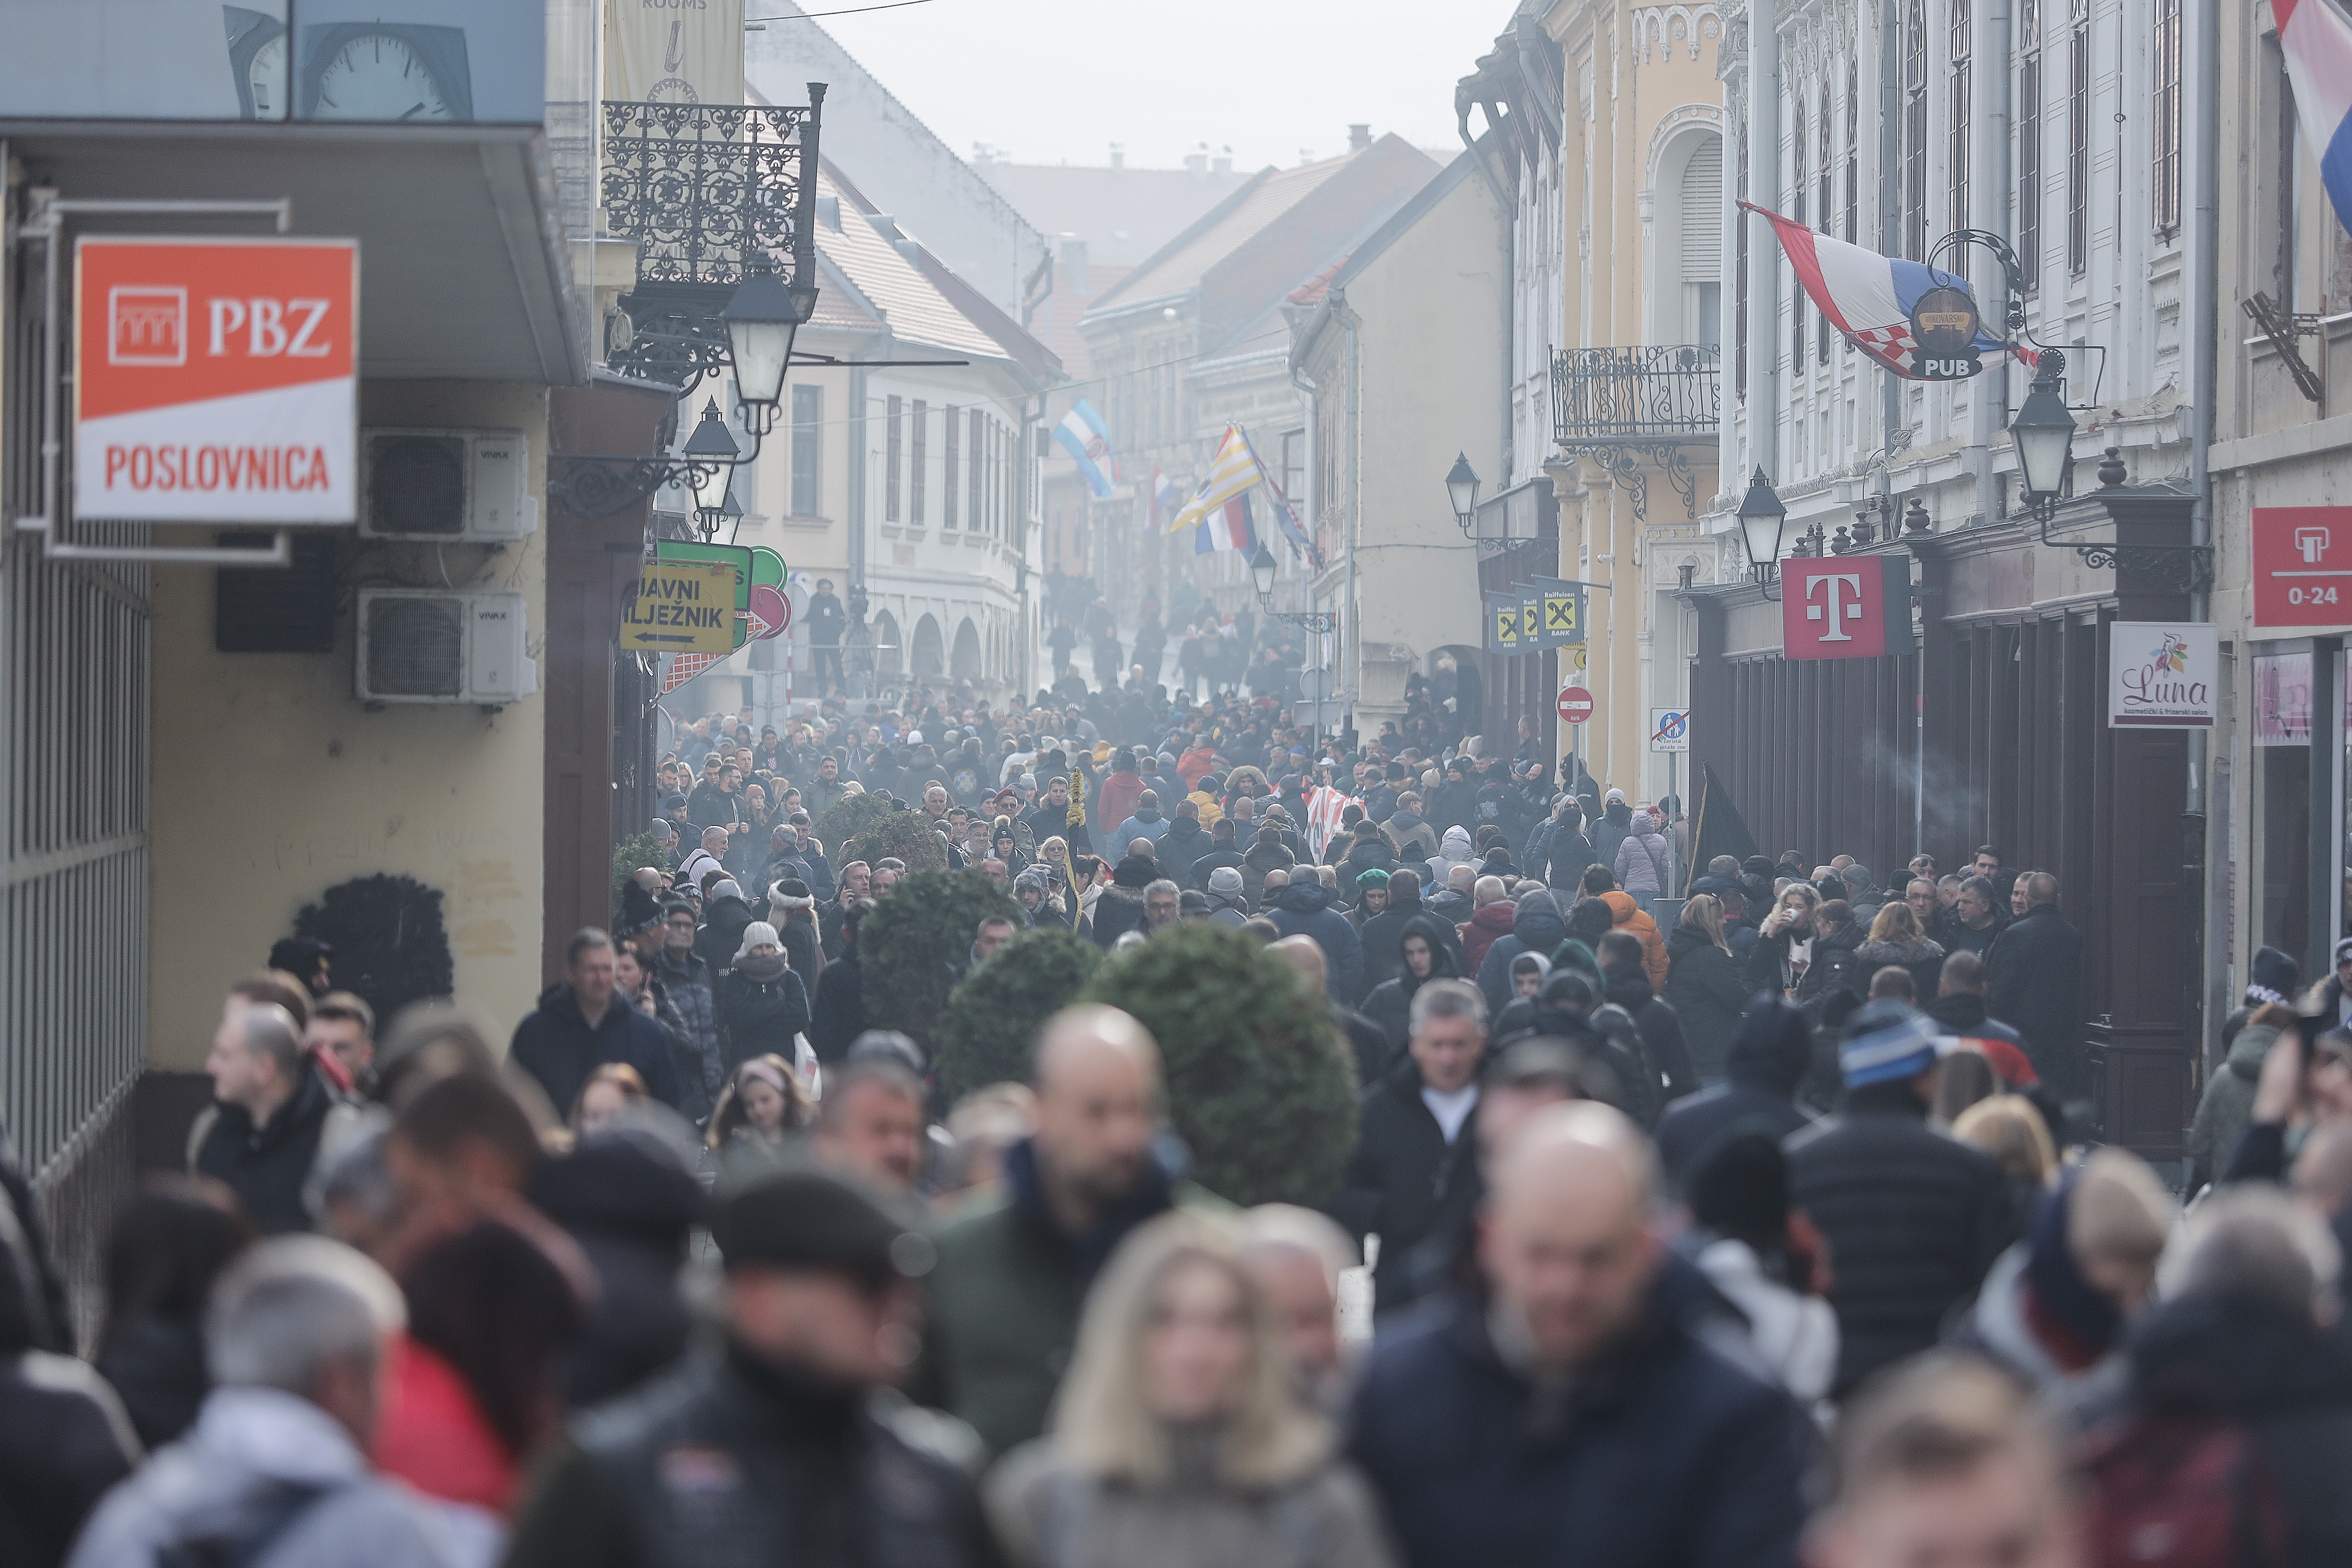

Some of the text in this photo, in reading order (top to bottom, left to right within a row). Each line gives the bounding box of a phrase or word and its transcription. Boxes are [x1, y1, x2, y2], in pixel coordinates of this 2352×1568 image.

[208, 298, 332, 357] PBZ
[1925, 314, 1964, 323] VUKOVARSKO
[1925, 359, 1969, 376] PUB
[105, 444, 330, 492] POSLOVNICA
[639, 577, 700, 600] JAVNI
[2288, 587, 2338, 604] 0-24
[2122, 664, 2208, 706] Luna
[719, 968, 730, 976] HNK
